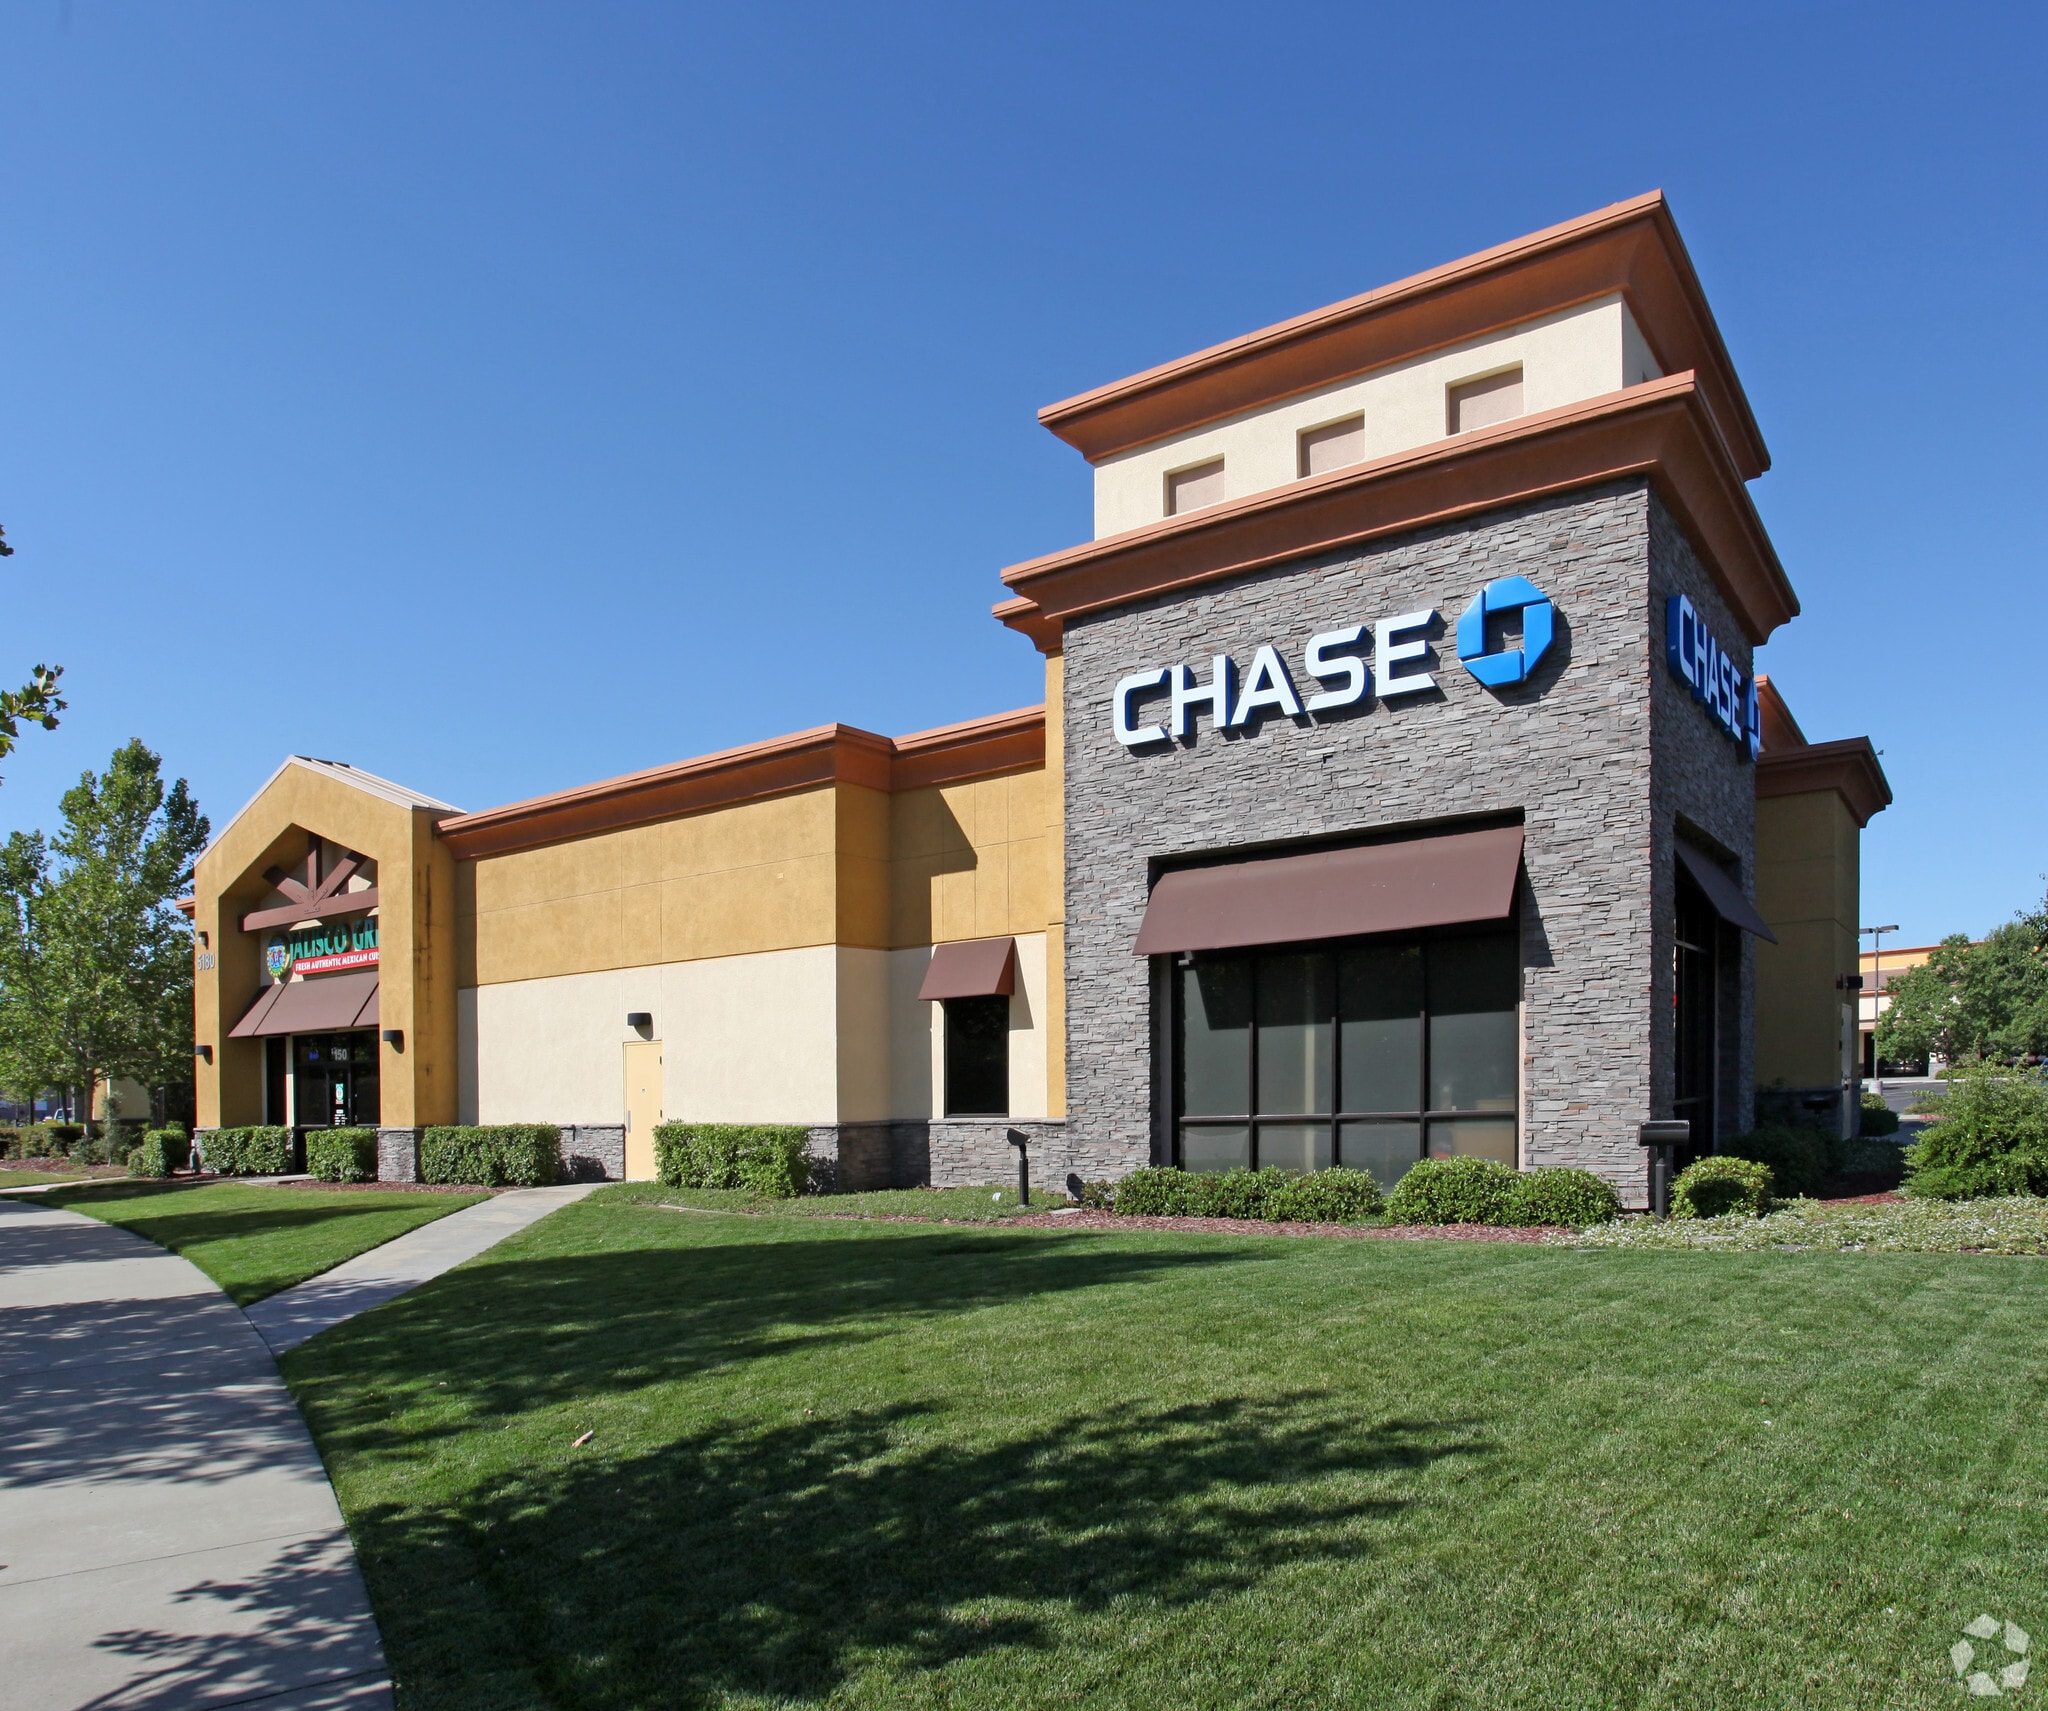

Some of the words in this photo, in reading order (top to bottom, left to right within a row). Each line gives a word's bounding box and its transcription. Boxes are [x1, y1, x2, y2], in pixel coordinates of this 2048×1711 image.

[1112, 607, 1440, 747] CHASE
[1677, 593, 1742, 742] CHASE
[289, 924, 347, 968] JALISCO
[295, 961, 311, 972] FRESH
[311, 957, 342, 970] AUTHENTIC
[342, 953, 368, 966] MEXICAN
